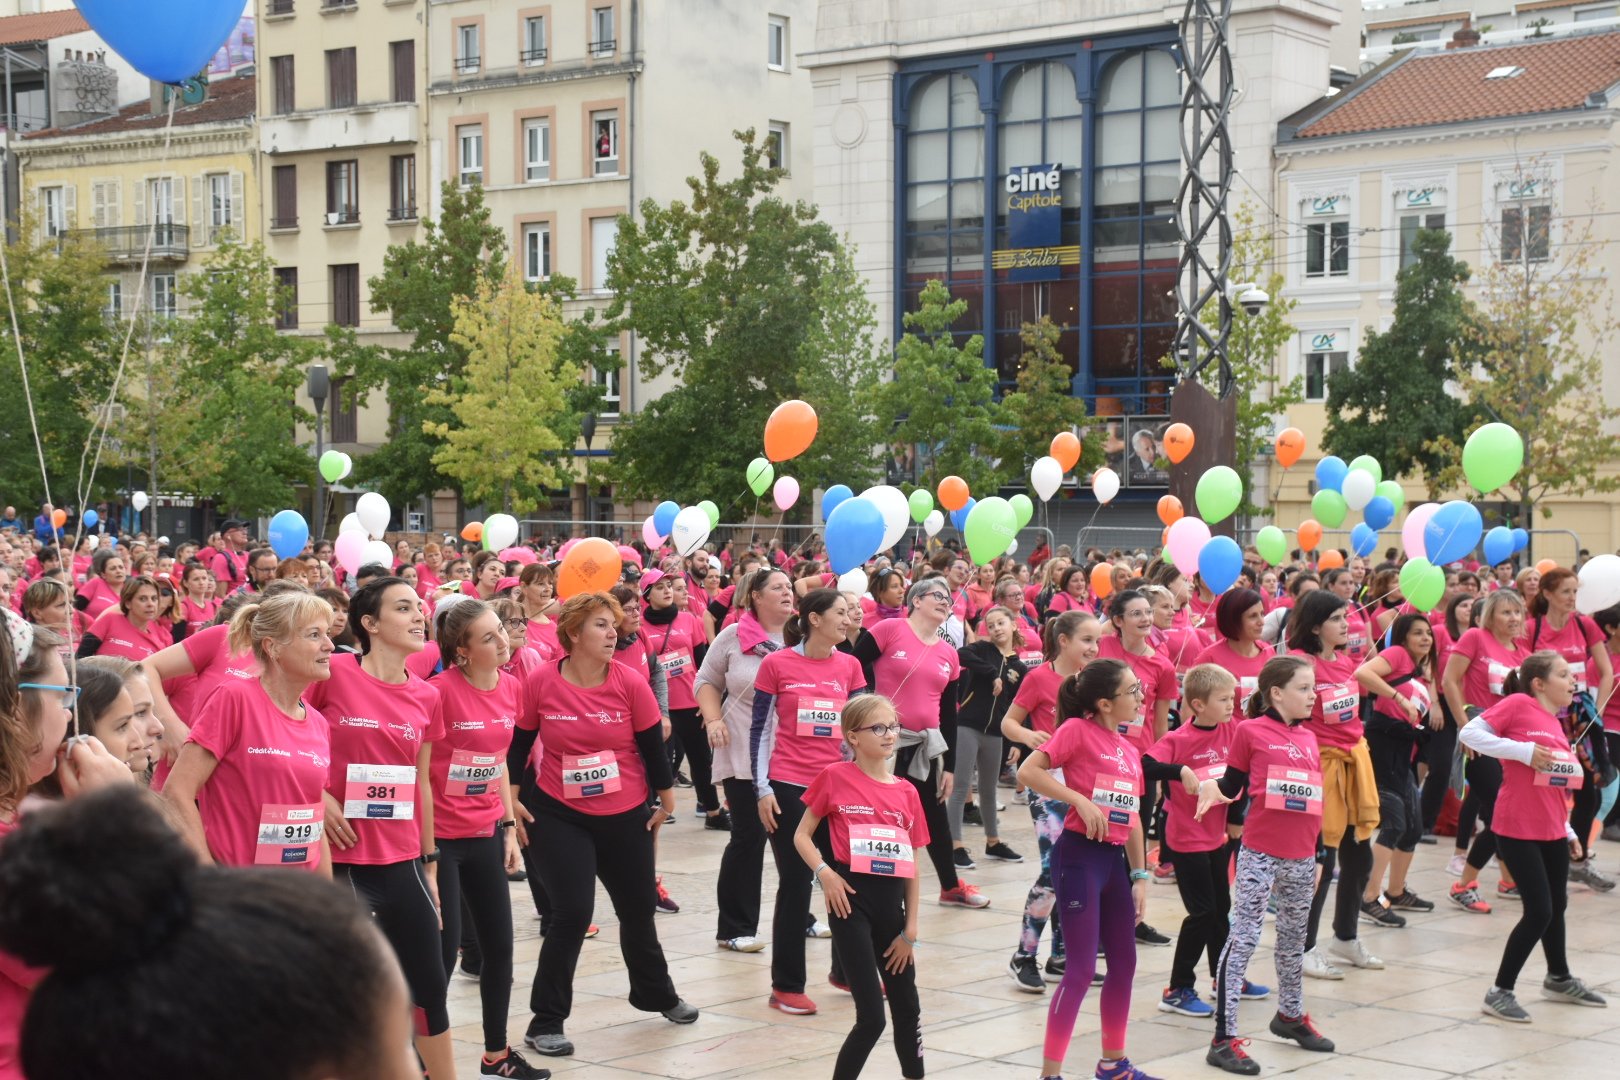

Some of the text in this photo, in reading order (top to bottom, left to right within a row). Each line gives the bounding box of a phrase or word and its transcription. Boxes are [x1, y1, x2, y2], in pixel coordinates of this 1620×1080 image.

[1006, 164, 1061, 193] ciné
[1008, 191, 1061, 213] Capitole
[1020, 248, 1059, 267] Salles
[1332, 697, 1355, 710] 6269
[811, 711, 837, 721] 1403
[466, 767, 495, 778] 1800
[574, 768, 607, 782] 6100
[366, 785, 396, 799] 381
[1280, 783, 1312, 797] 4660
[1108, 792, 1134, 806] 1406
[284, 825, 312, 839] 919
[867, 841, 901, 855] 1444
